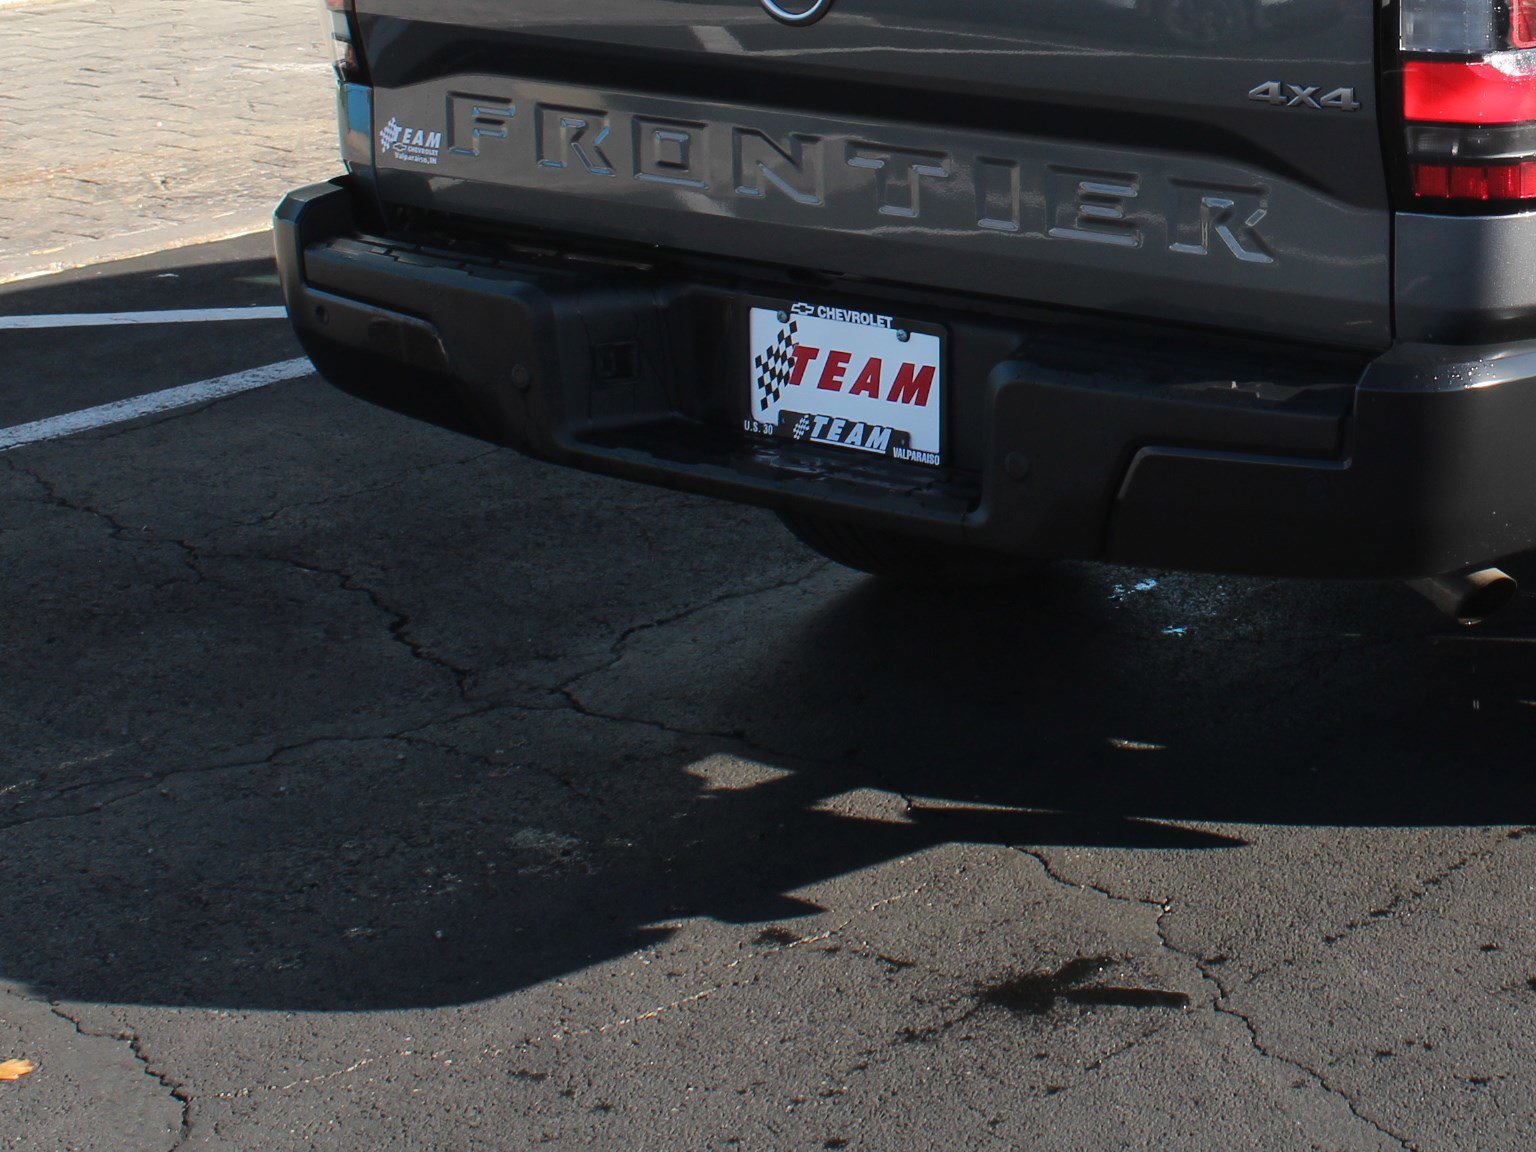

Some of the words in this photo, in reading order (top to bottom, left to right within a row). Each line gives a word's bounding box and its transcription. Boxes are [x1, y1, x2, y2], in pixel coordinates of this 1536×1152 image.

[393, 126, 442, 148] TEAM
[444, 90, 1274, 264] FRONTIER
[817, 305, 893, 329] CHEVROLET
[788, 345, 936, 408] TEAM
[744, 419, 761, 434] U.S.
[763, 423, 773, 436] 30
[810, 414, 893, 452] TEAM
[892, 446, 940, 466] VALPARAISO
